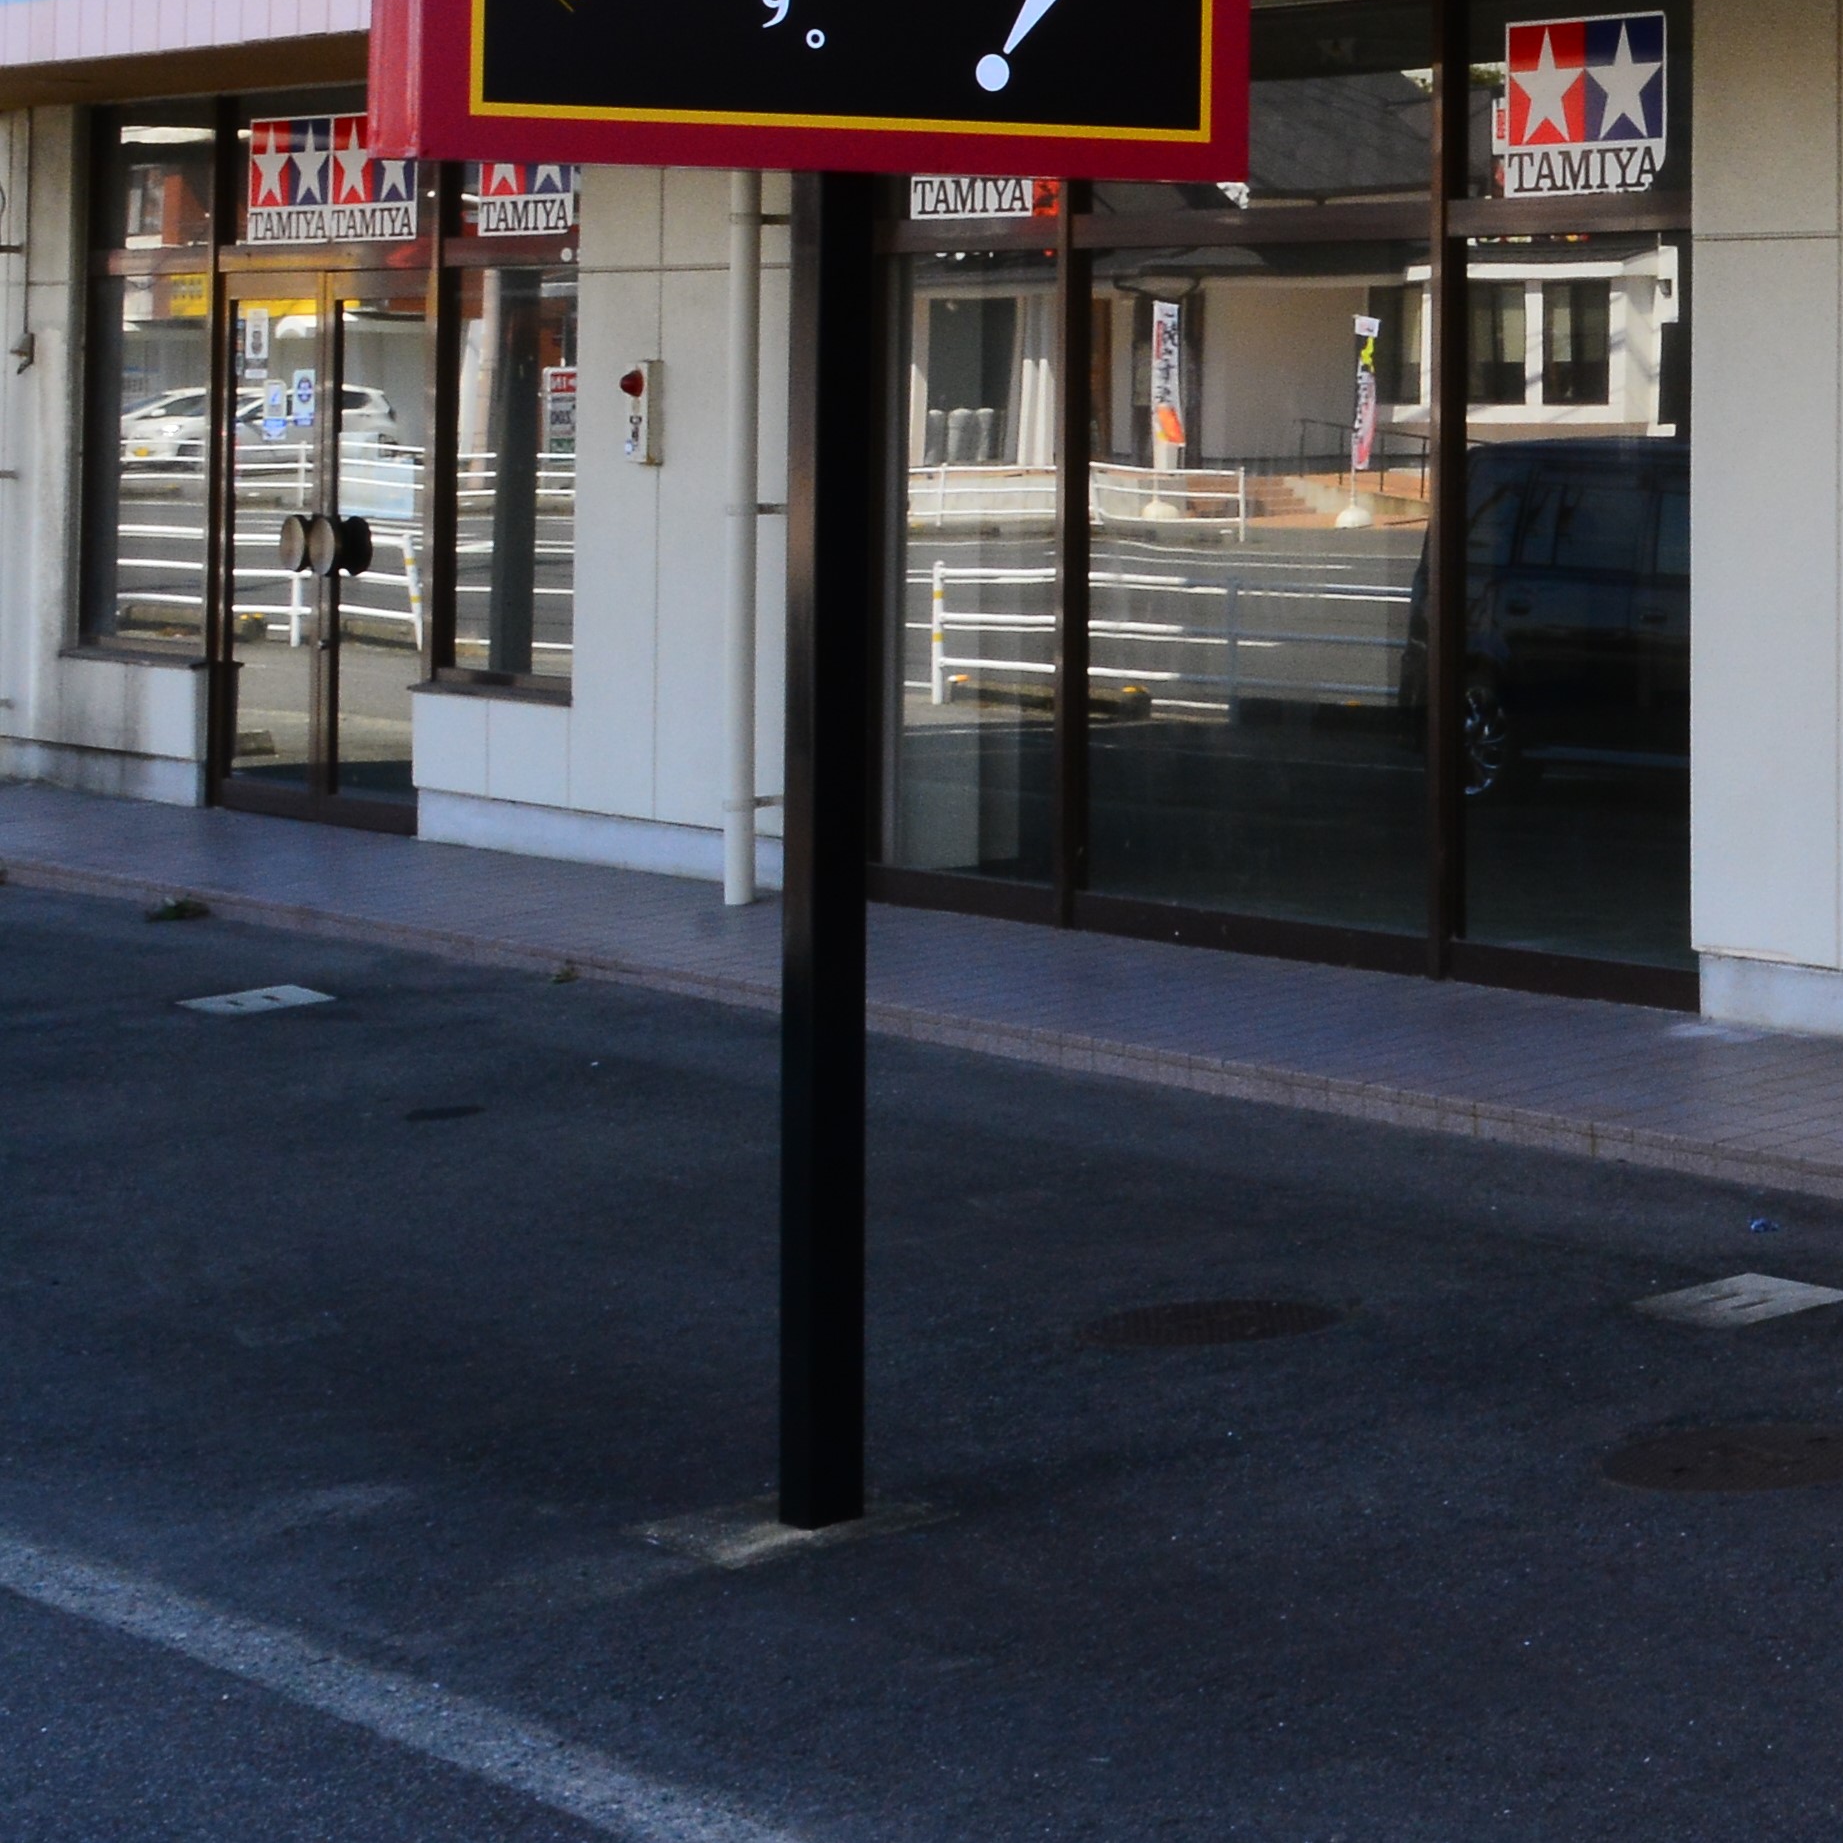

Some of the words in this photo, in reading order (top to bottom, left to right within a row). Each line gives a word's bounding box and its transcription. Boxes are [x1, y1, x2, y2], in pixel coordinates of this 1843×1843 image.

[1507, 145, 1659, 193] TAMIYA
[912, 178, 1030, 215] TAMIYA
[249, 208, 328, 240] TAMIYA
[331, 206, 415, 238] TAMIYA
[481, 199, 570, 233] TAMIYA
